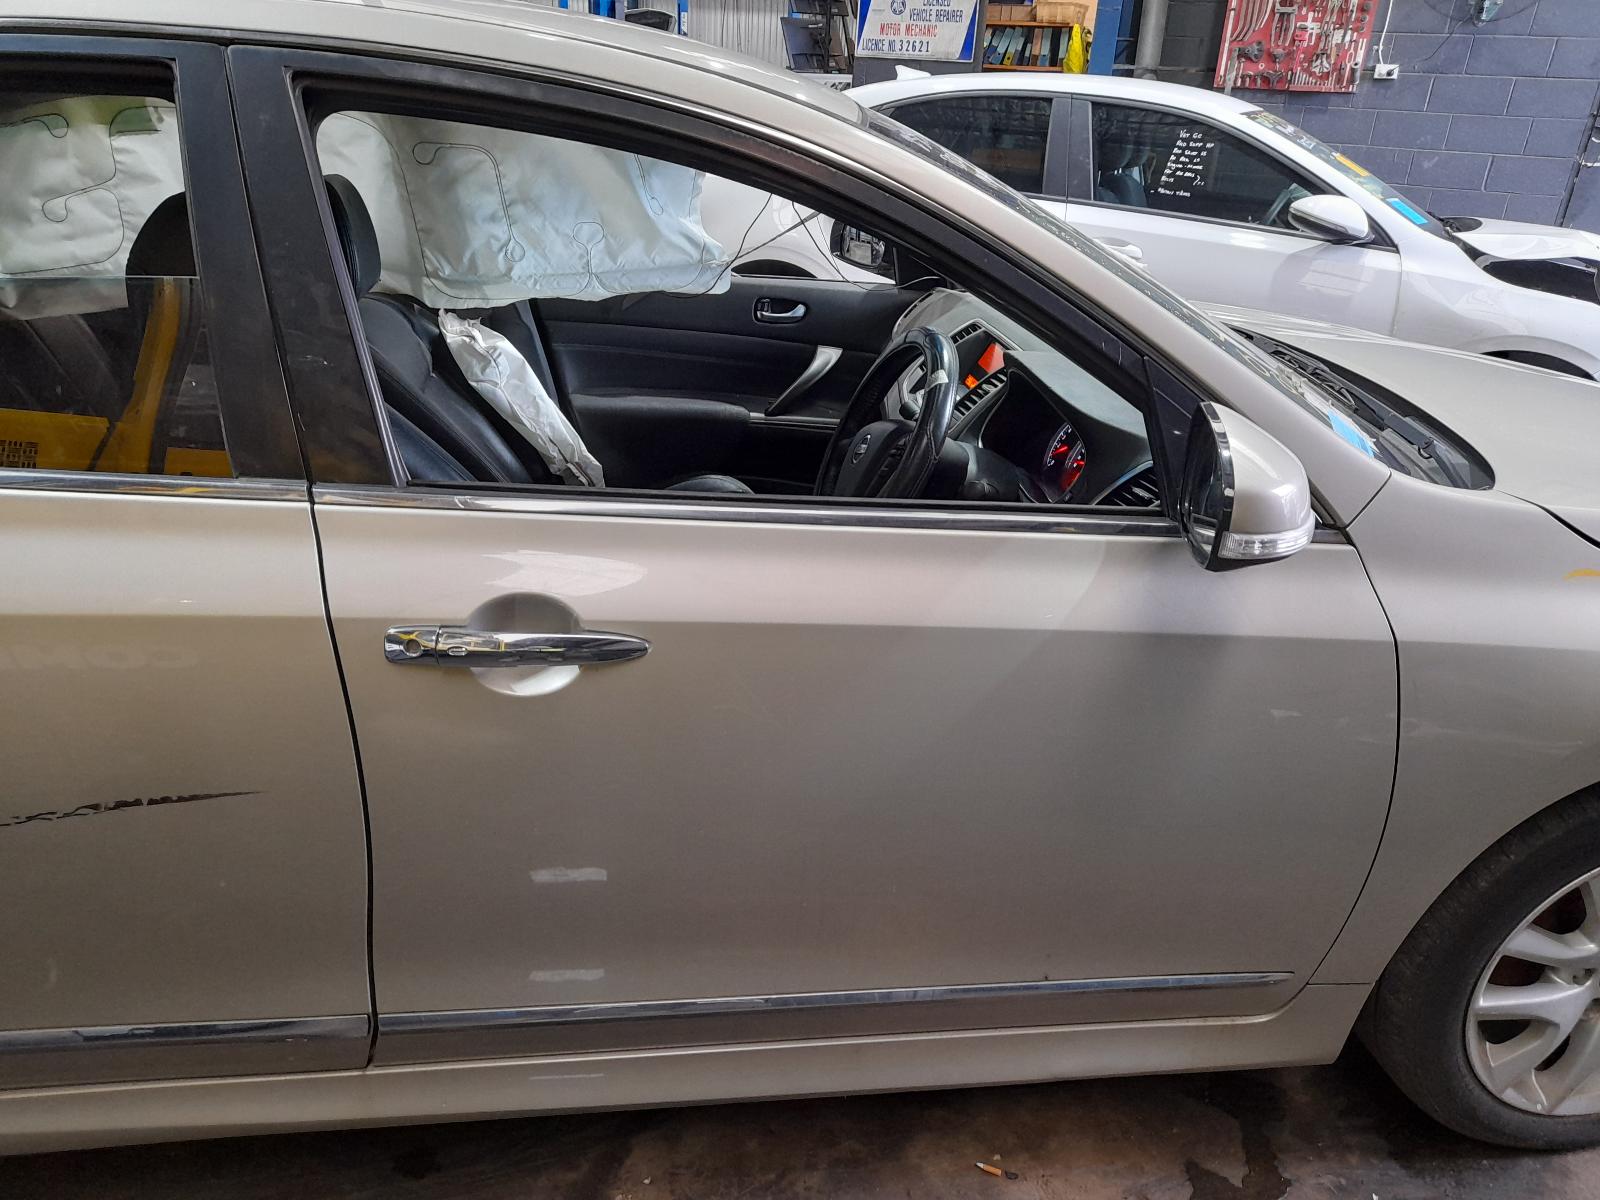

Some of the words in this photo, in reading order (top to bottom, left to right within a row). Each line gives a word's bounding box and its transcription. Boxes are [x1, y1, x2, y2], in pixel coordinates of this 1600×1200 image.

[909, 8, 933, 22] VEHICLE
[935, 9, 964, 23] REPAIRER
[879, 22, 901, 36] MOTOR
[905, 23, 938, 37] MECHANIC
[862, 38, 886, 52] LICENCE
[899, 39, 930, 52] 32621
